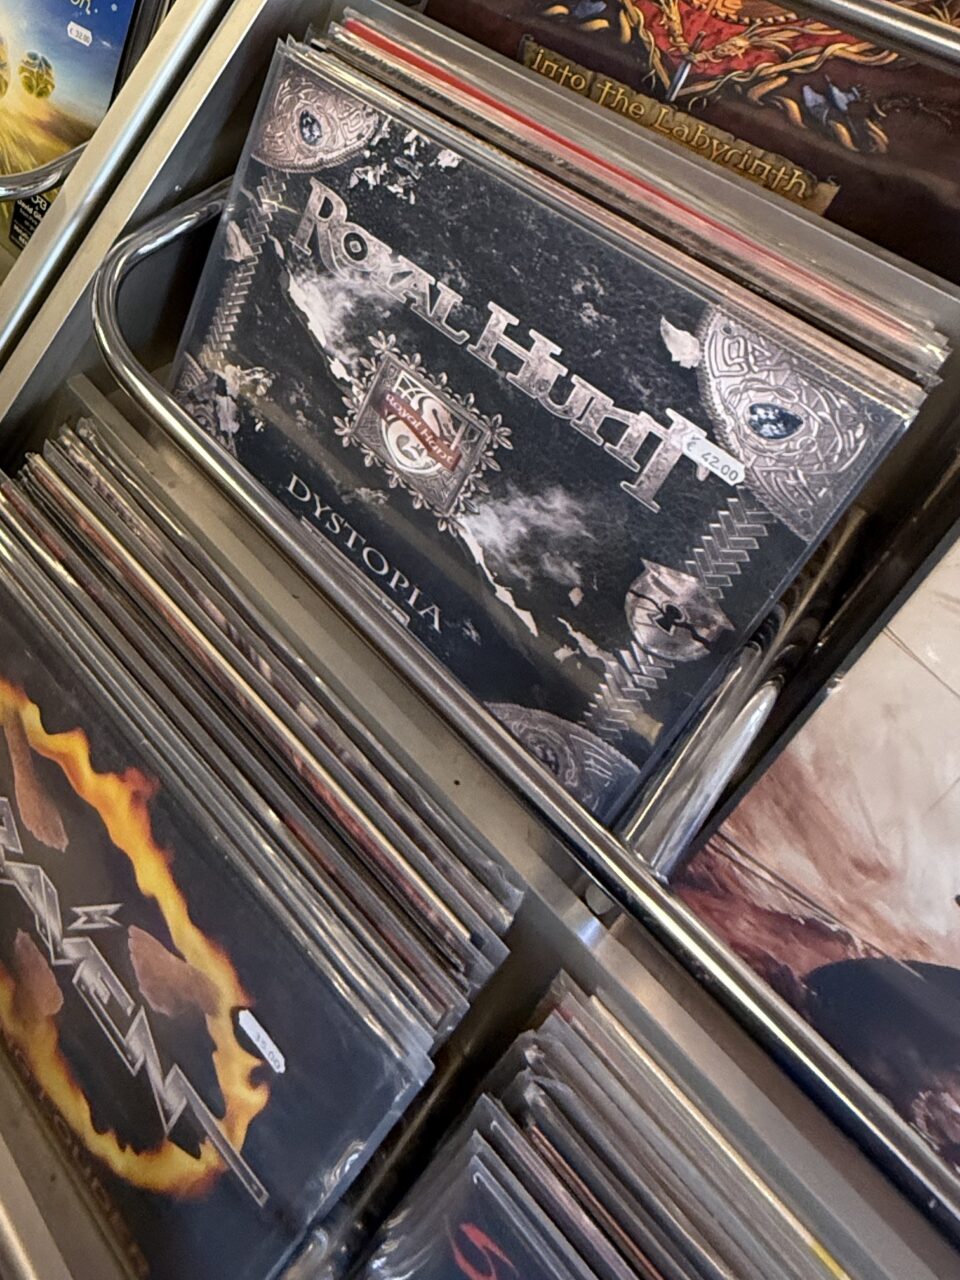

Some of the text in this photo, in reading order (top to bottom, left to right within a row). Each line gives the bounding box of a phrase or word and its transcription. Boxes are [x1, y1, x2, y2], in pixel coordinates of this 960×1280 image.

[531, 49, 809, 201] into the Labyrinth
[289, 175, 709, 514] ROYAL HUNT
[385, 392, 423, 430] Royal
[286, 473, 443, 634] DYSTOPIA
